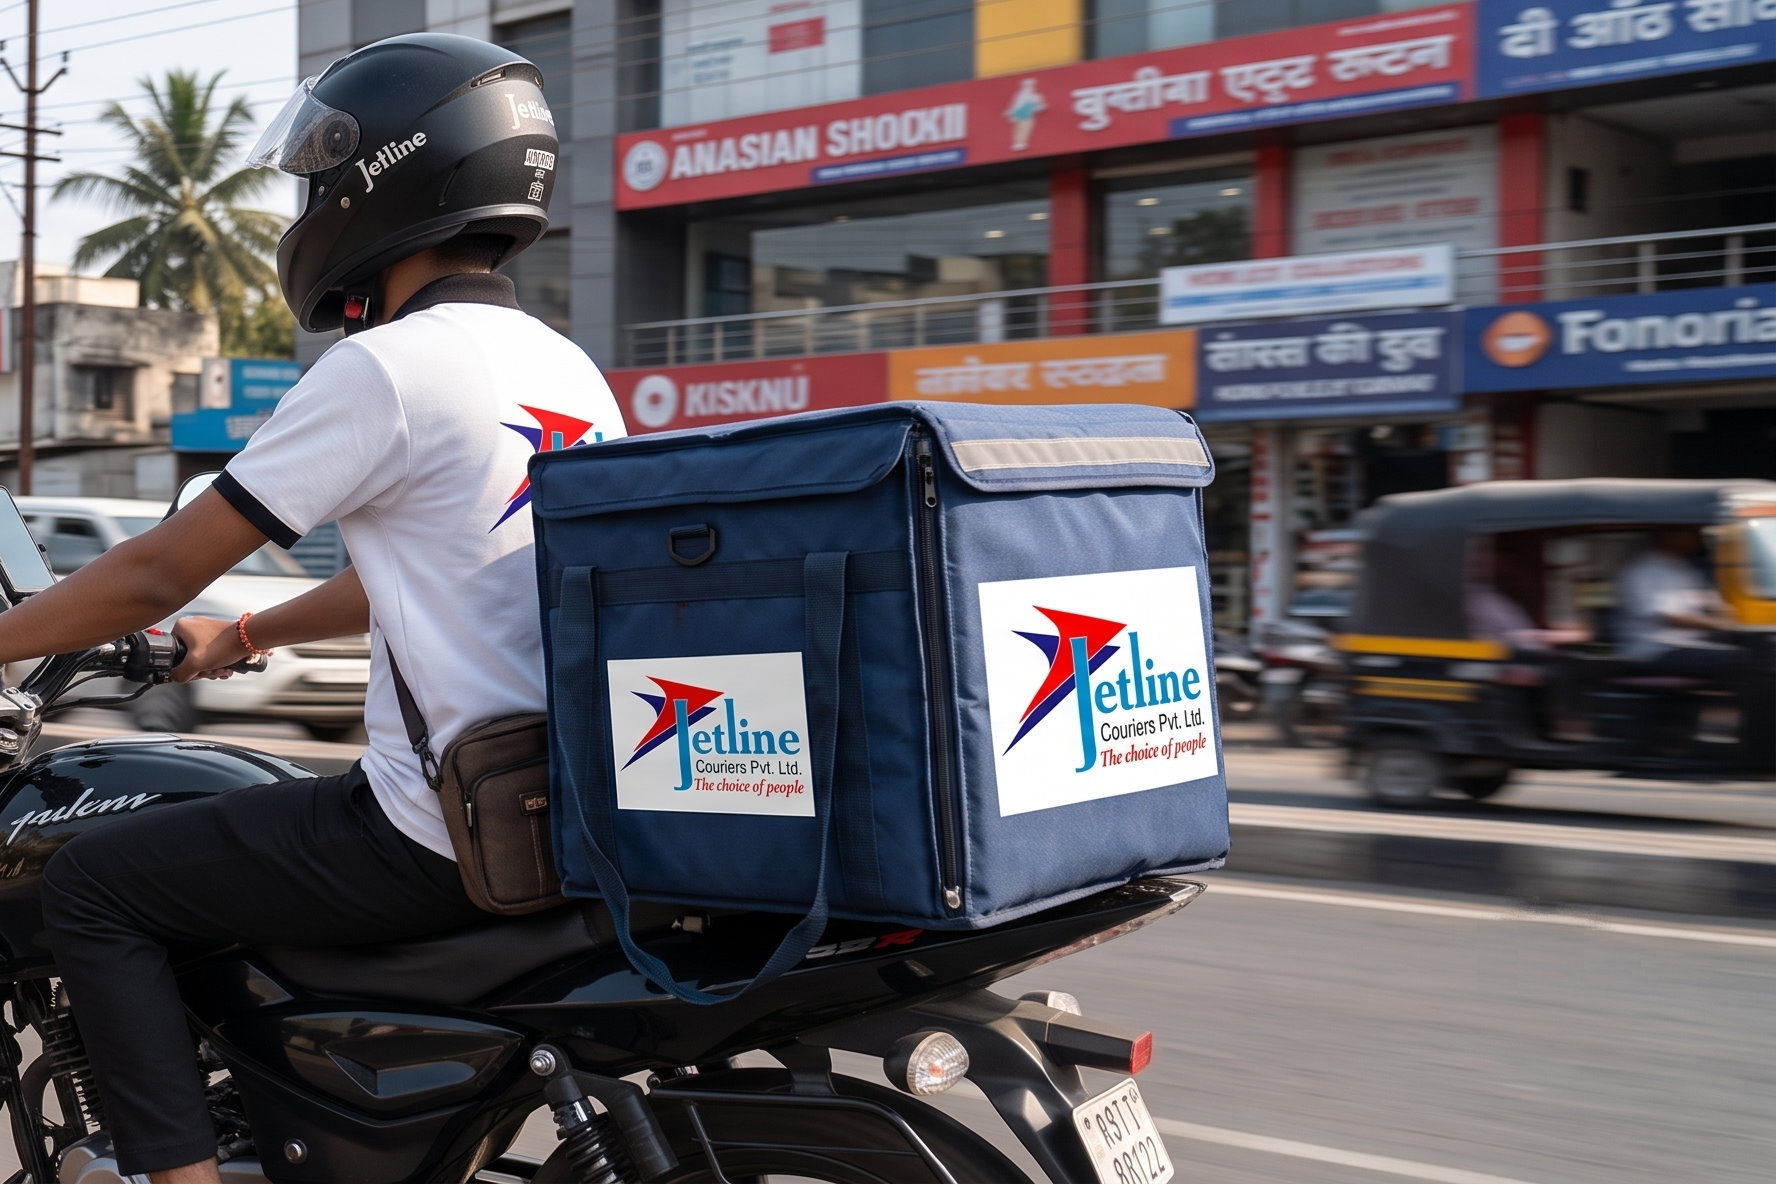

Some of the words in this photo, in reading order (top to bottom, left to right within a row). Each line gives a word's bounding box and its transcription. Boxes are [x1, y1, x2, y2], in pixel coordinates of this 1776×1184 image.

[355, 132, 427, 193] Jetline
[1070, 631, 1202, 773] Jetline
[1100, 718, 1156, 742] Couriers
[1159, 711, 1182, 732] Pvt.
[1184, 708, 1205, 728] Ltd.
[673, 698, 801, 791] Jetline
[1100, 748, 1122, 767] The
[1125, 742, 1159, 763] choice
[1161, 738, 1174, 760] of
[1174, 732, 1207, 759] people
[695, 759, 747, 774] Couriers
[750, 760, 775, 775] Pvt.
[778, 761, 802, 776] Ltd.
[694, 778, 714, 791] The
[717, 778, 750, 792] choice
[753, 779, 766, 797] of
[766, 779, 805, 798] people
